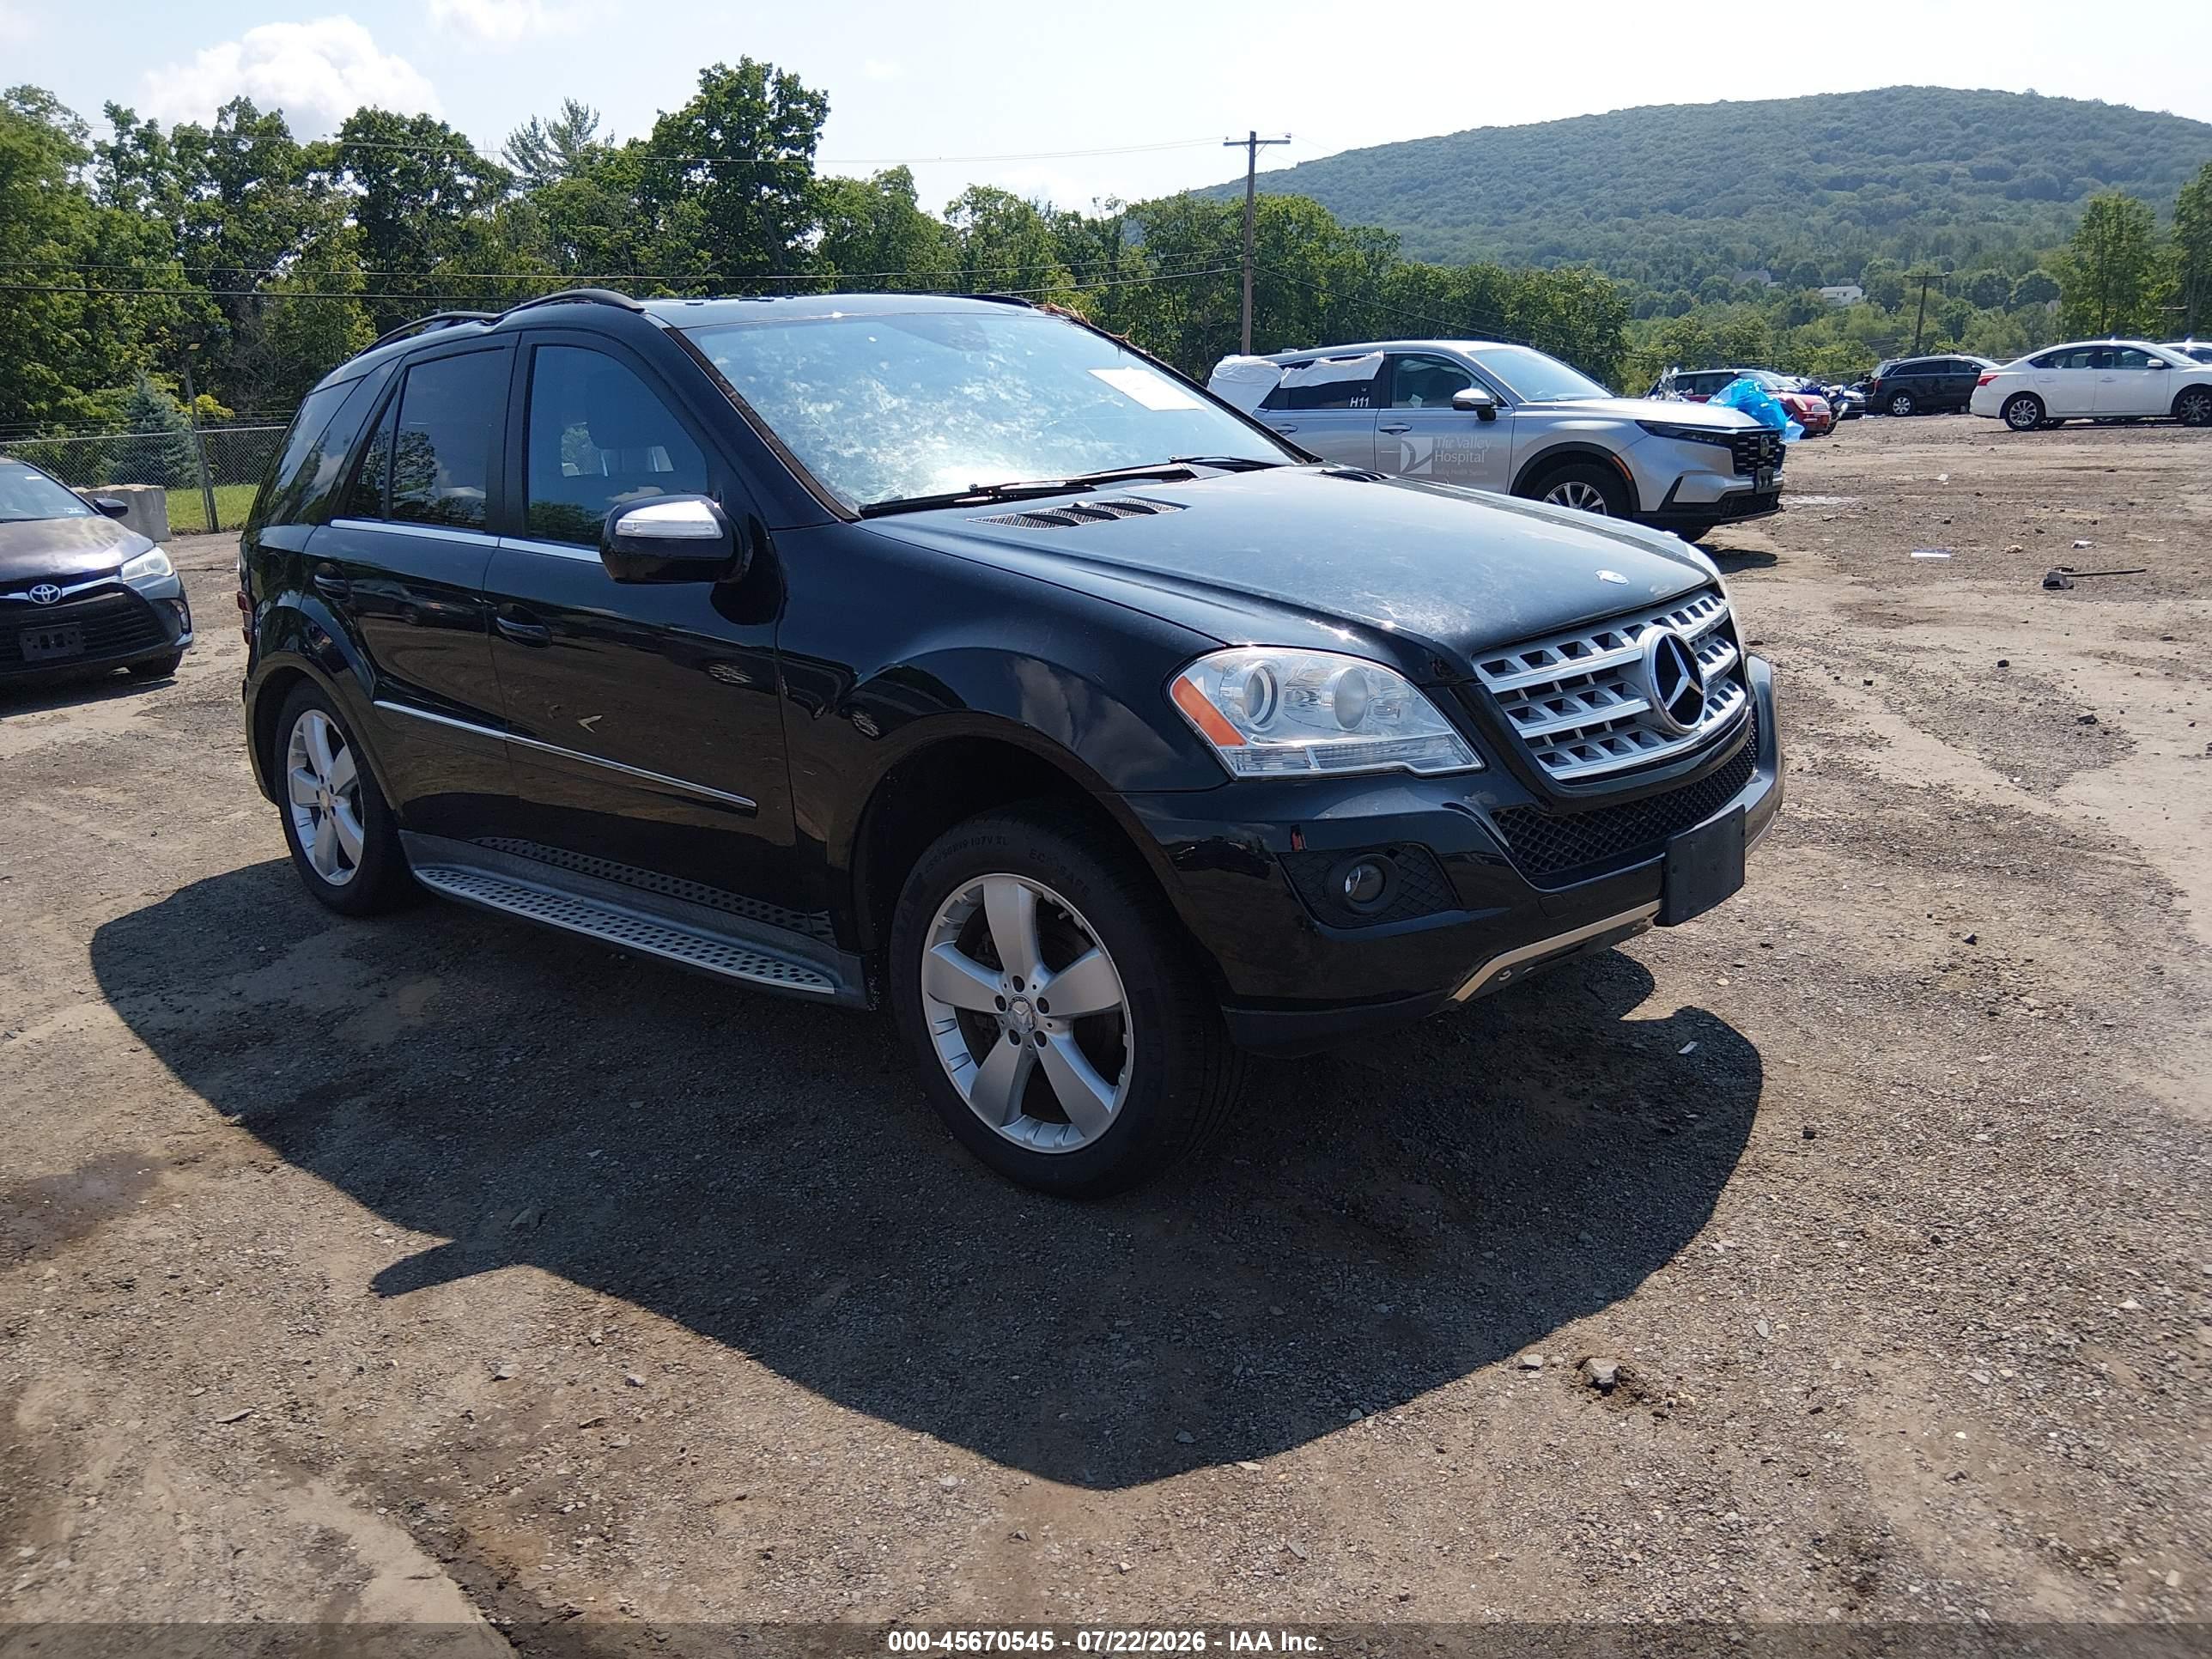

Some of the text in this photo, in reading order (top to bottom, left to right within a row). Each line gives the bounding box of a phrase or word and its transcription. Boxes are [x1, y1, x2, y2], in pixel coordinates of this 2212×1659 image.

[1350, 397, 1370, 408] H11
[1455, 434, 1492, 453] Valley
[1435, 449, 1485, 465] Hospital
